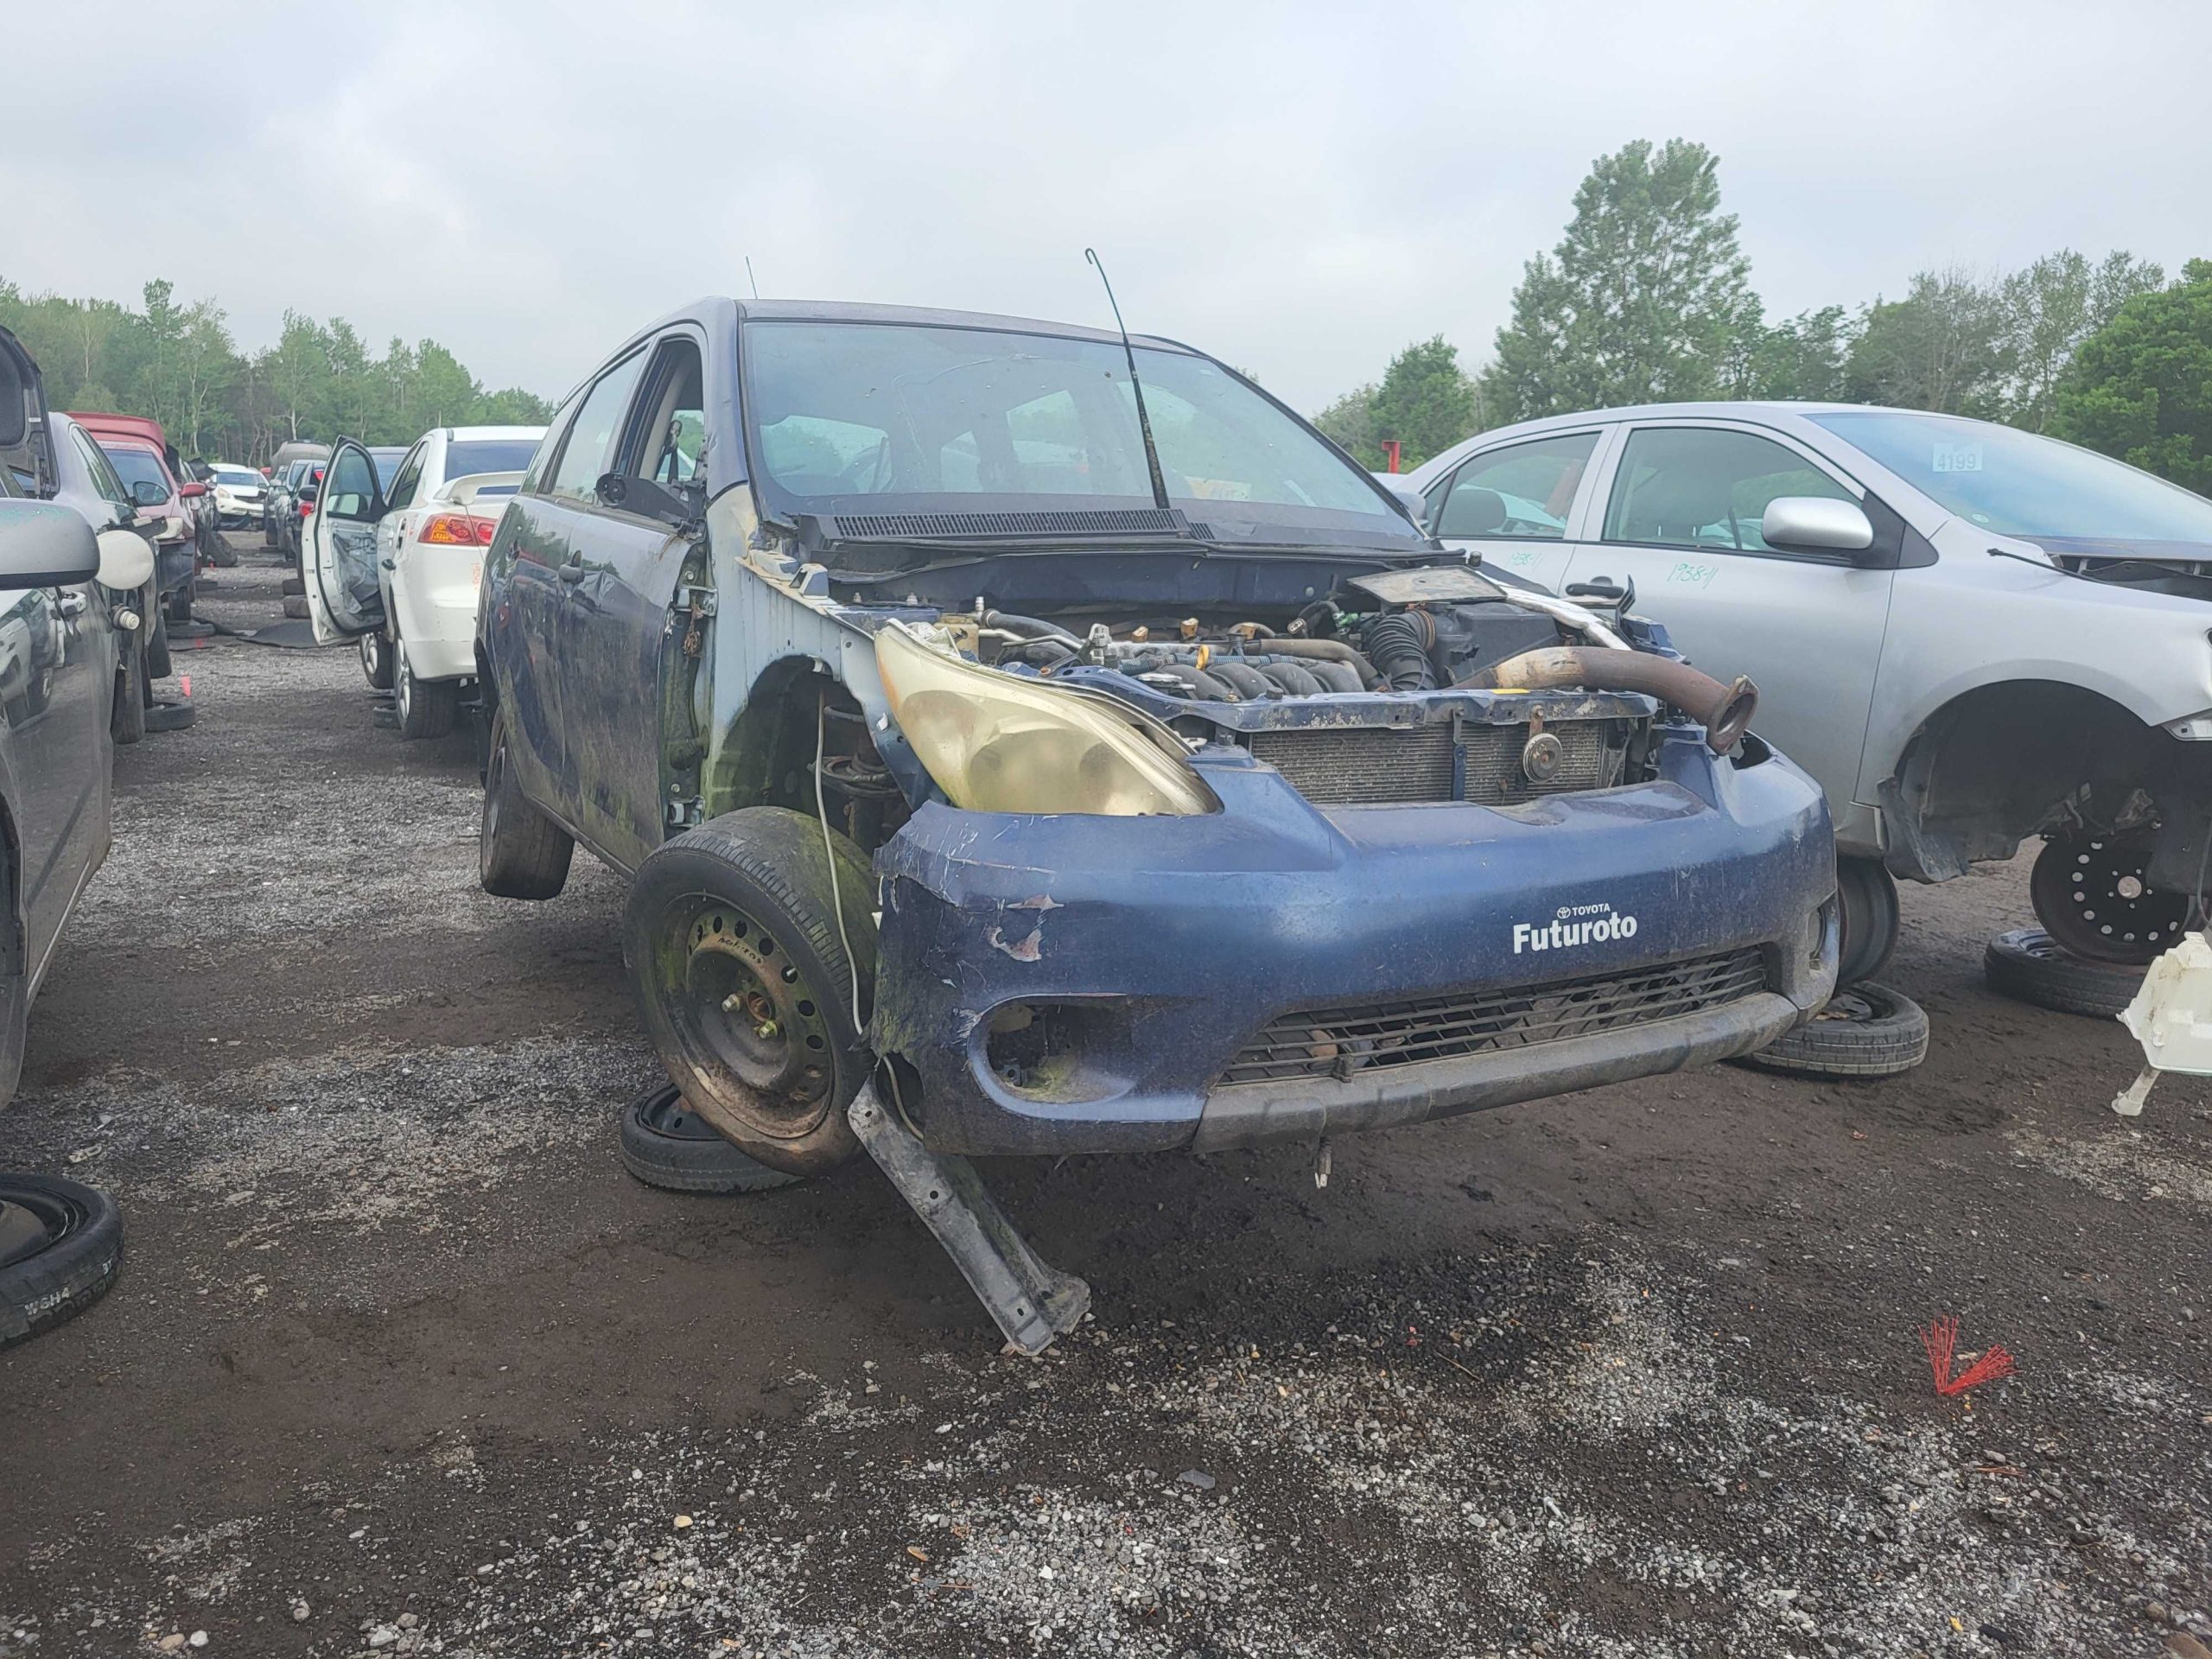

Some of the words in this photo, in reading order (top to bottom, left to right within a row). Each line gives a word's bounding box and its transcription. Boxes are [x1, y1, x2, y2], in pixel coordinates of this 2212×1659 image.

[1938, 454, 1977, 470] 4199
[1572, 903, 1611, 917] TOYOTA
[1513, 912, 1637, 954] Futuroto
